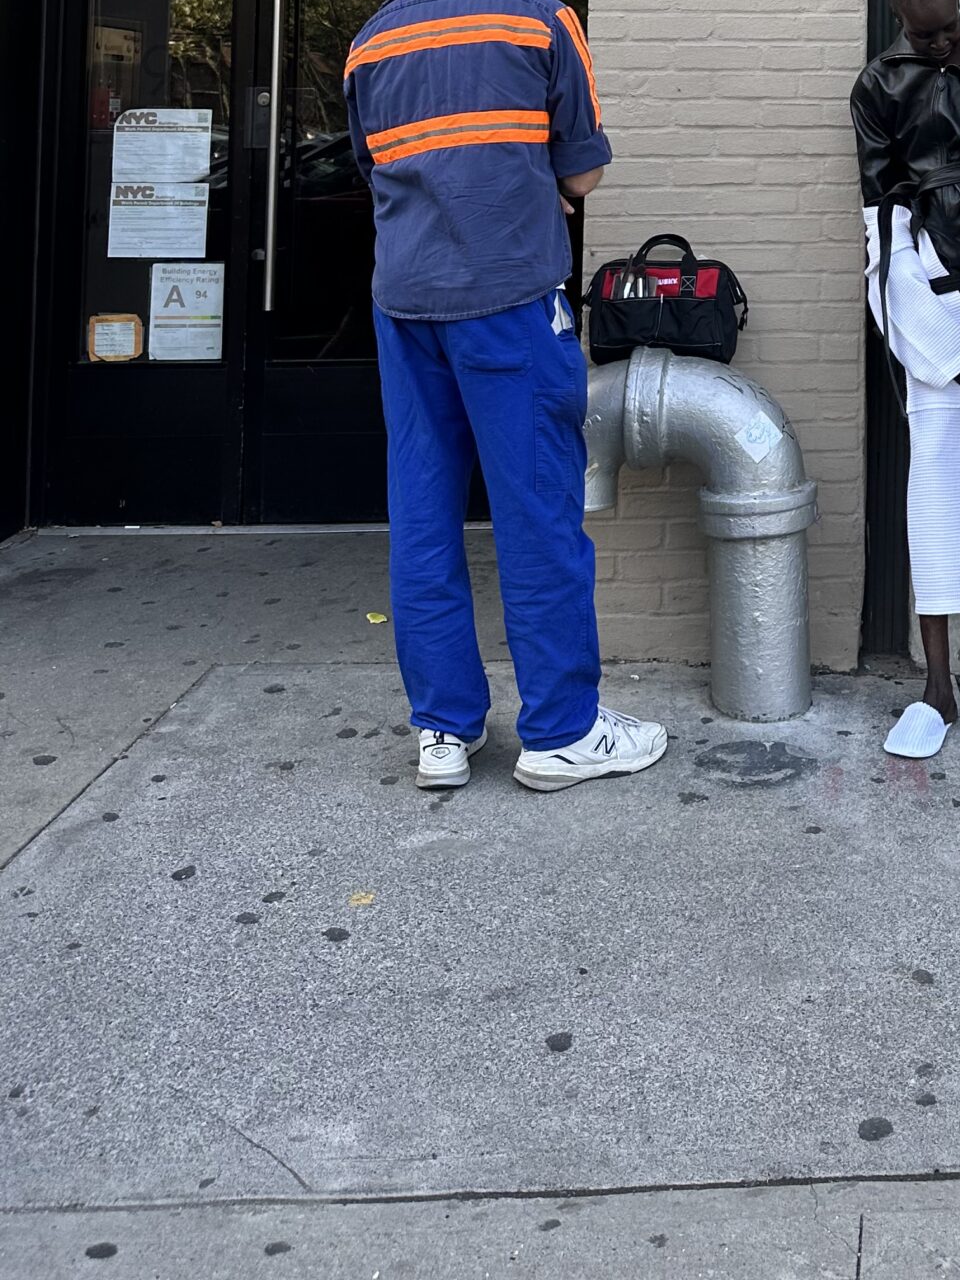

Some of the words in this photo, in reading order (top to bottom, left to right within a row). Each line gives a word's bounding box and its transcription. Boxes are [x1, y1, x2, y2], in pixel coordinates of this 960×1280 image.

[118, 112, 158, 125] NYC
[115, 186, 155, 199] NYC
[162, 268, 191, 276] Building
[163, 284, 186, 309] A
[195, 290, 208, 299] 94
